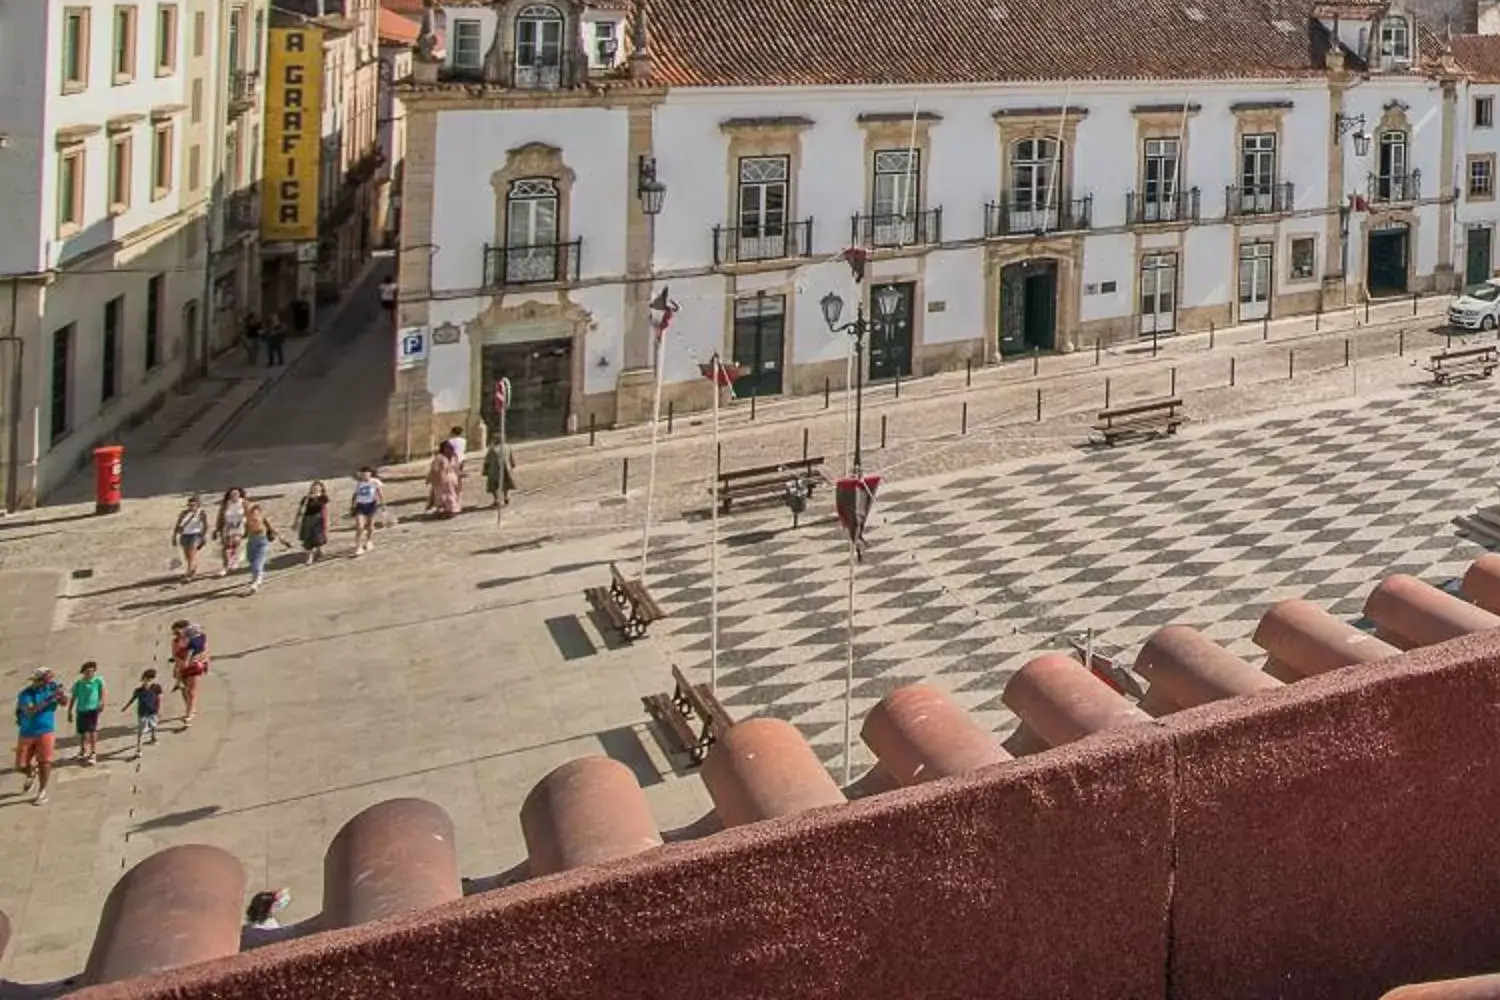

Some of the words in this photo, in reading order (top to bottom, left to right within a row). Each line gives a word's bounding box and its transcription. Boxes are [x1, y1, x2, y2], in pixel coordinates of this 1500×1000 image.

[286, 33, 304, 53] A
[279, 65, 305, 223] GRAFICA
[407, 337, 419, 353] P
